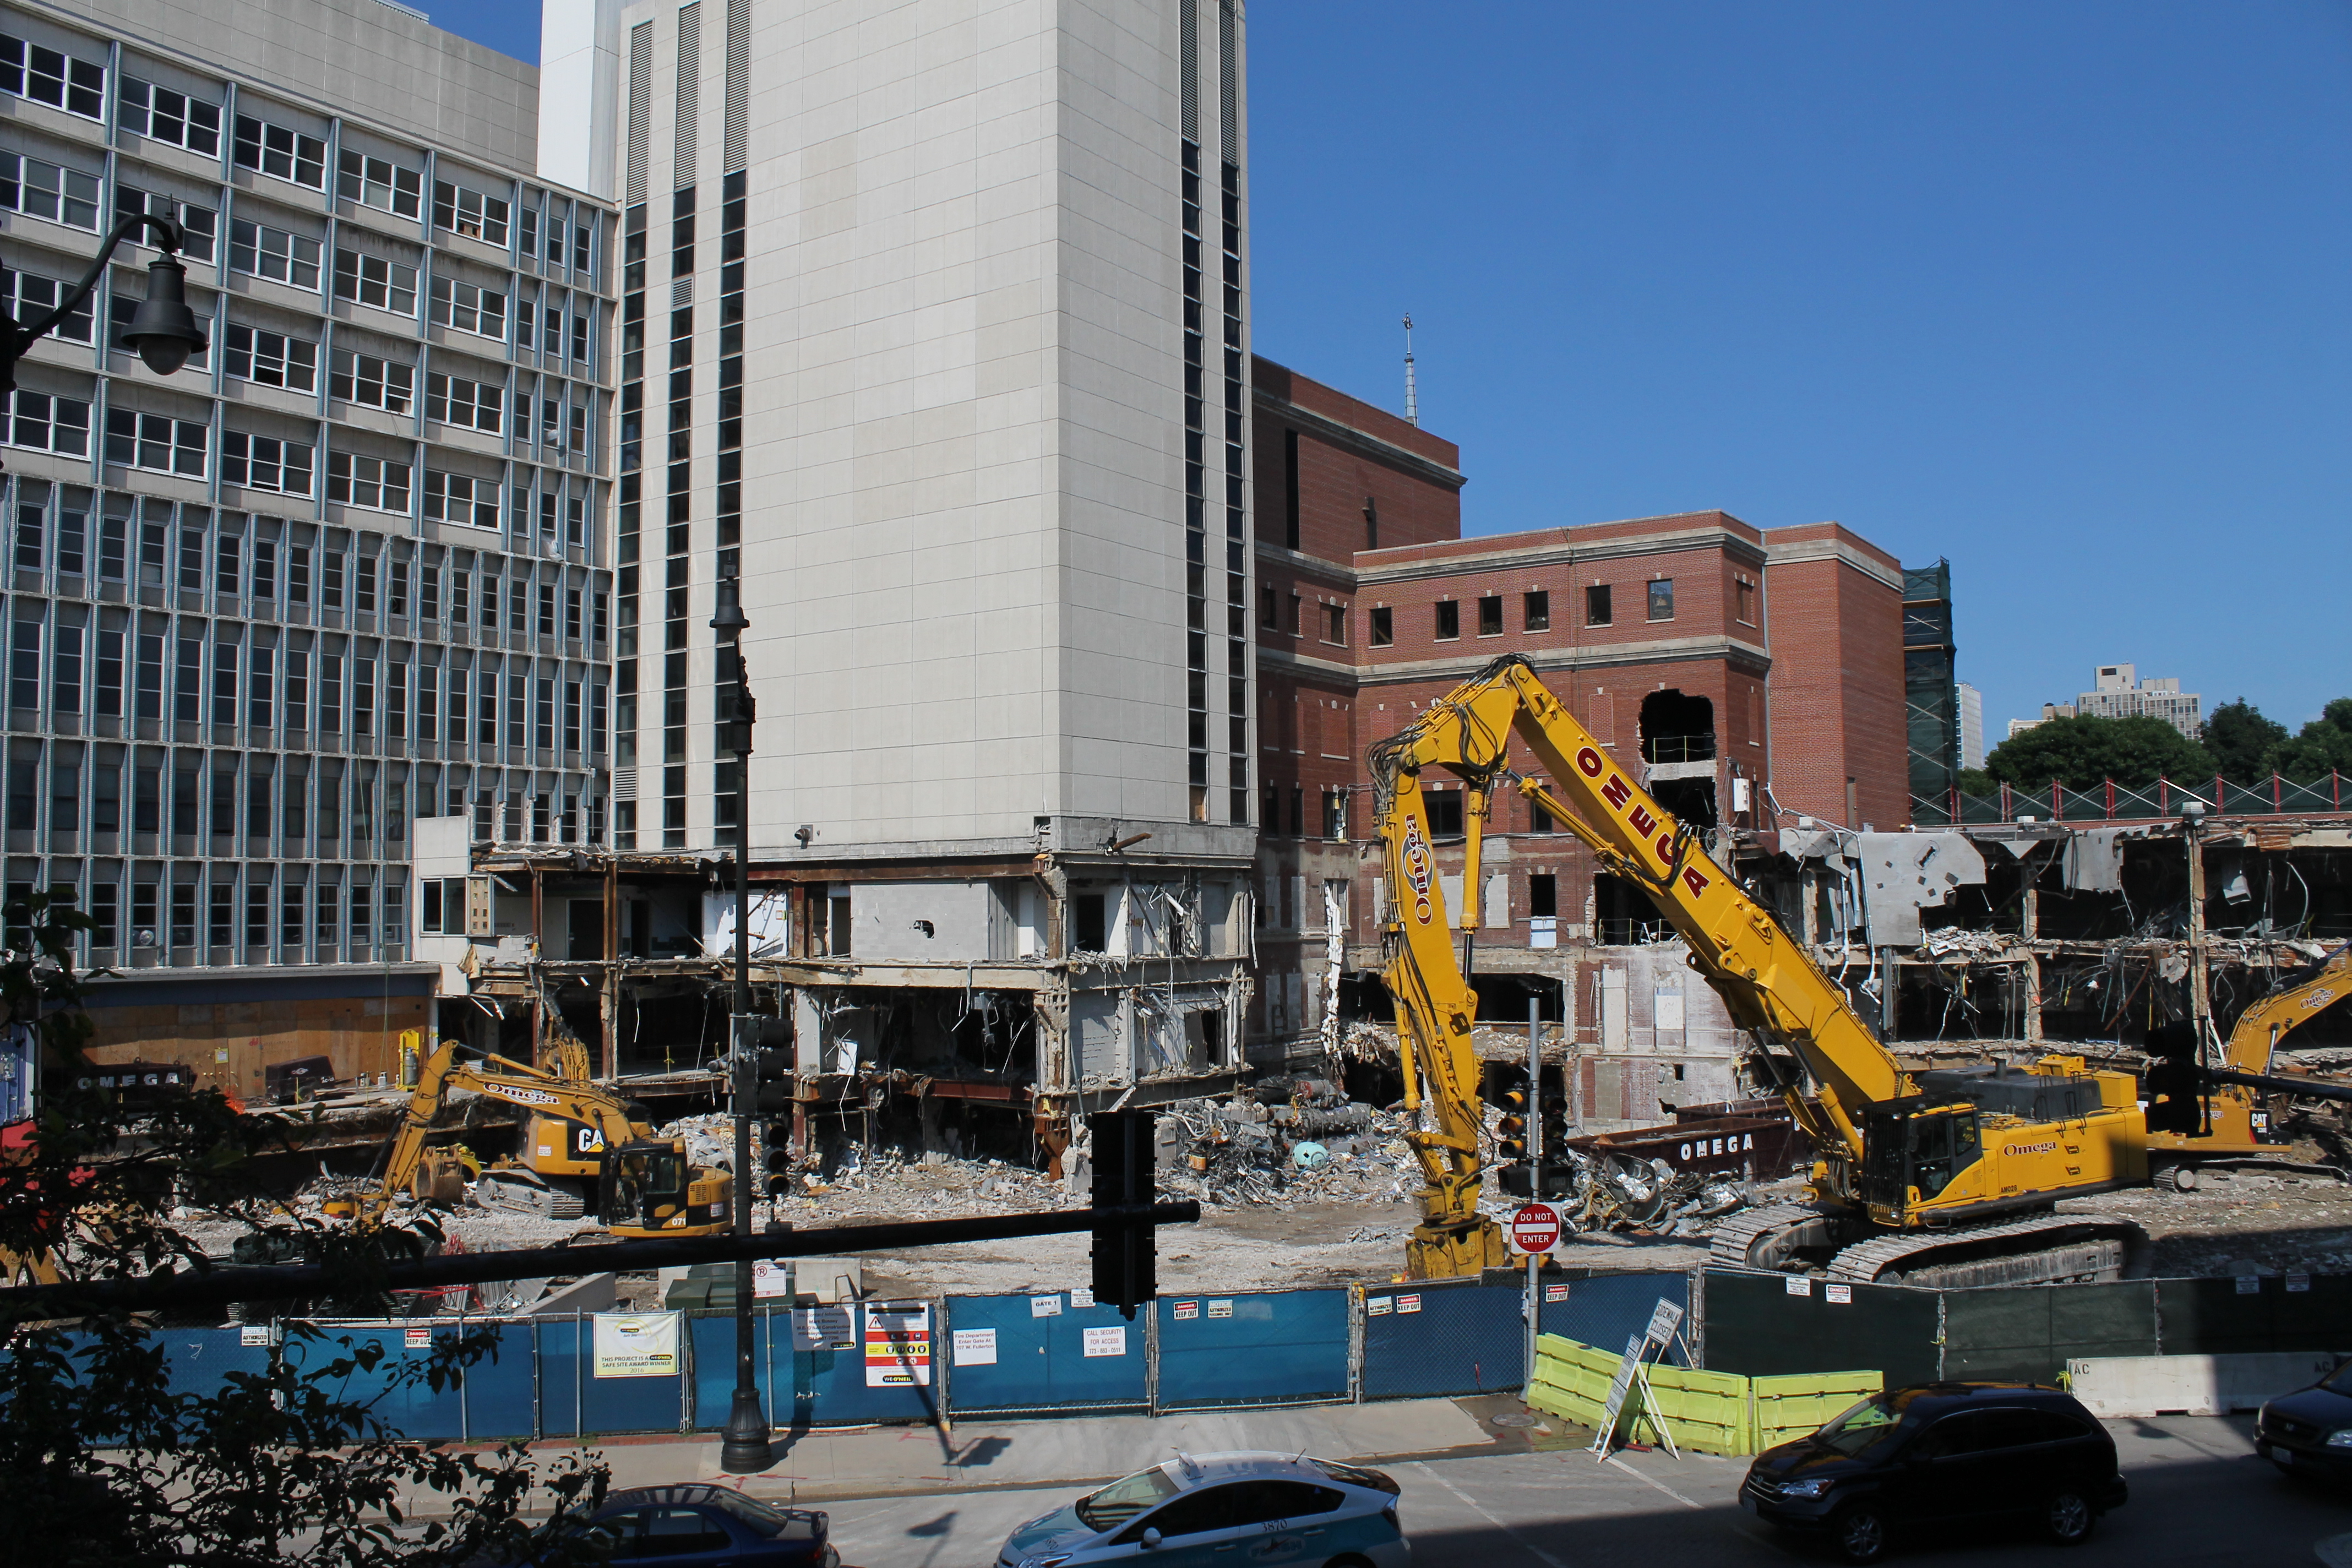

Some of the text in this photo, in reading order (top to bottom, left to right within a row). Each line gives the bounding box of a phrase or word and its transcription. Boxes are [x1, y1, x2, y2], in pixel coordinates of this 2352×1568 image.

[1576, 746, 1711, 900] OMEGA
[1405, 812, 1433, 925] Omega
[2300, 989, 2335, 1009] Omega
[78, 1072, 179, 1089] OMEGA
[483, 1082, 560, 1104] Omega
[2252, 1113, 2267, 1127] CAT
[578, 1129, 605, 1152] CA
[1681, 1134, 1754, 1161] OMEGA
[2003, 1141, 2057, 1156] Omega
[672, 1217, 686, 1226] 071
[1535, 1213, 1551, 1221] NOT
[1522, 1235, 1549, 1243] ENTER
[1656, 1304, 1679, 1325] SIDEWALK
[1651, 1319, 1672, 1341] CLOSED
[2075, 1364, 2089, 1374] AC
[2315, 1361, 2330, 1372] AC
[1262, 1519, 1287, 1532] 3870
